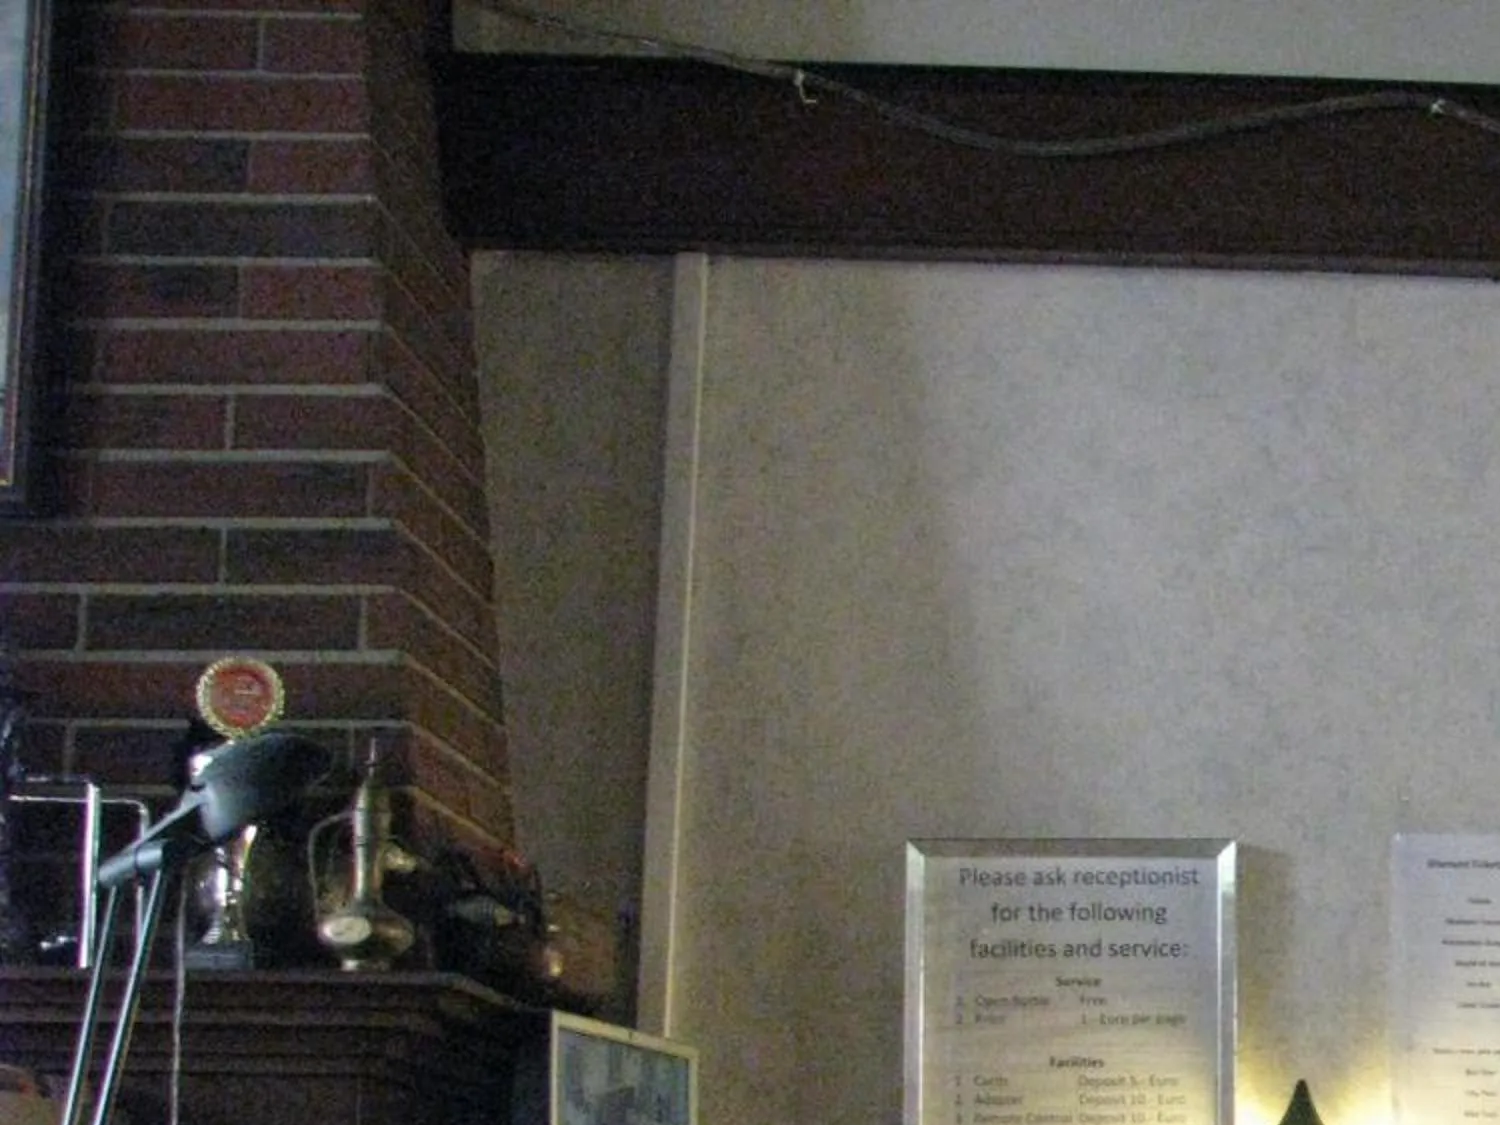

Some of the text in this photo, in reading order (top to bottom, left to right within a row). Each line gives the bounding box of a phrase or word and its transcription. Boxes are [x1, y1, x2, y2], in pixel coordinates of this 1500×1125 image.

[959, 867, 1200, 889] Please ask receptionist
[990, 902, 1169, 925] for the following
[970, 938, 1190, 959] facilities and service:
